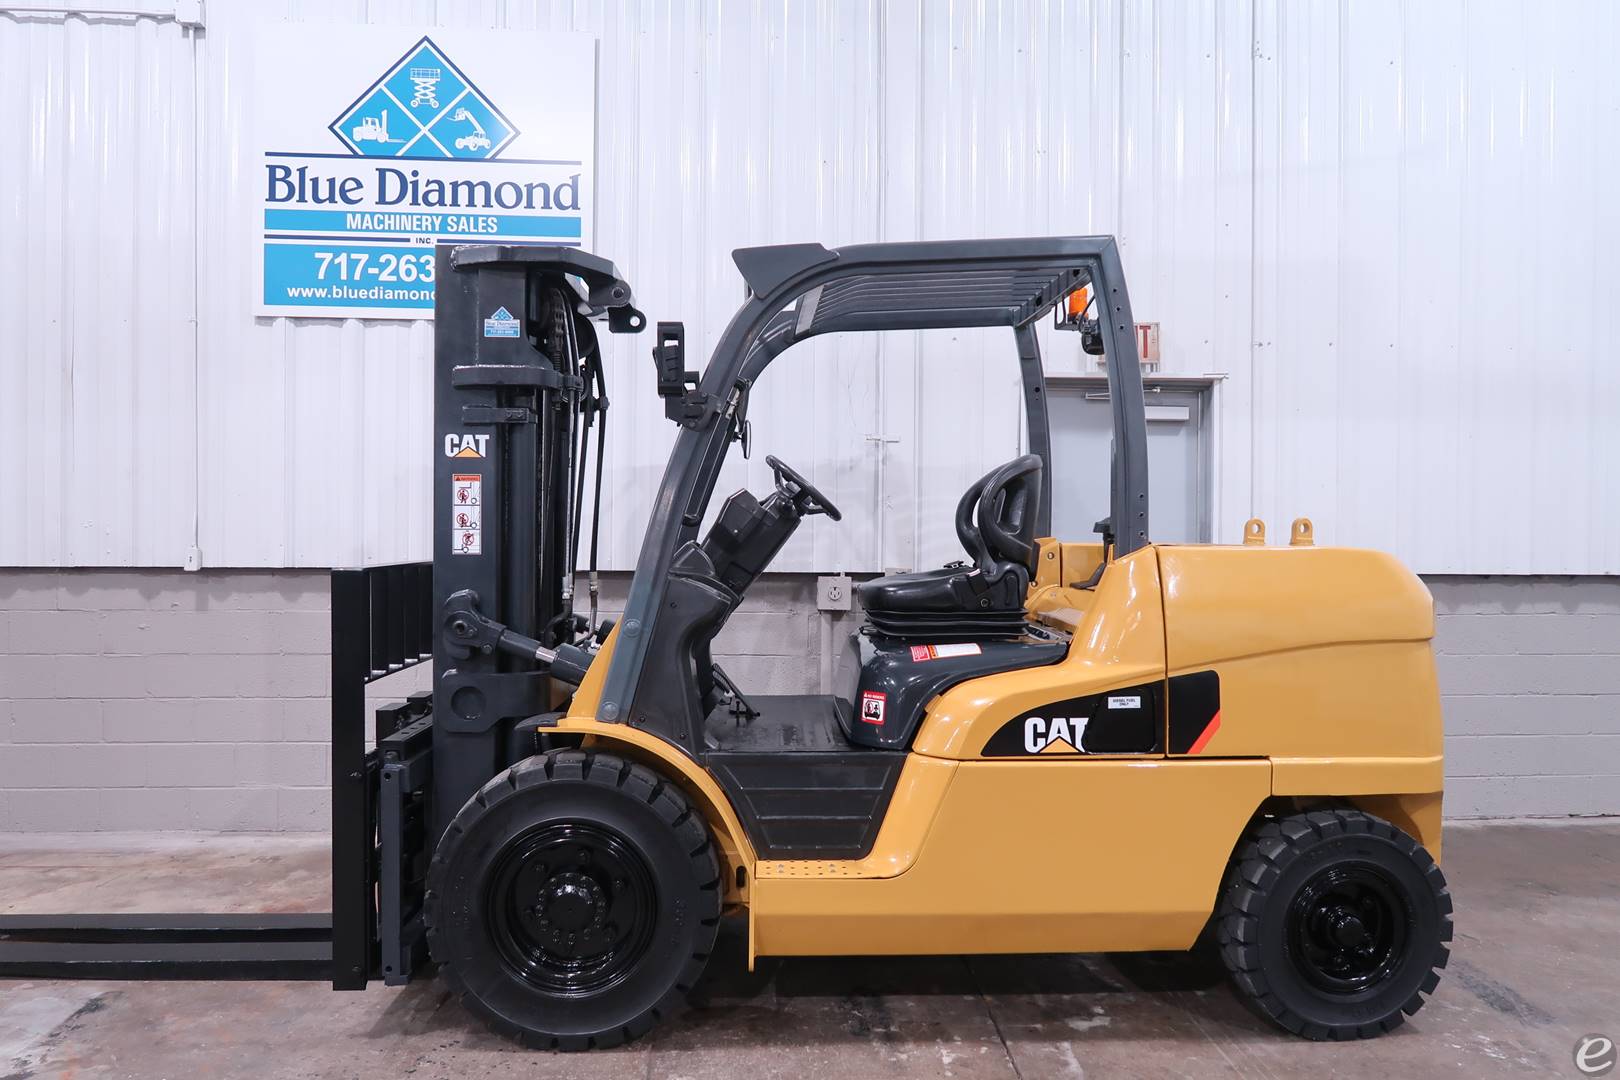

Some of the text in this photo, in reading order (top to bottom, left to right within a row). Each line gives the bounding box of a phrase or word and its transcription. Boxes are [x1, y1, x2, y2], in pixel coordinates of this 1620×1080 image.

[265, 164, 581, 211] Blue Diamond
[346, 213, 498, 234] MACHINERY SALES
[416, 237, 434, 245] INC.
[444, 433, 490, 457] CAT
[1024, 717, 1090, 753] CAT
